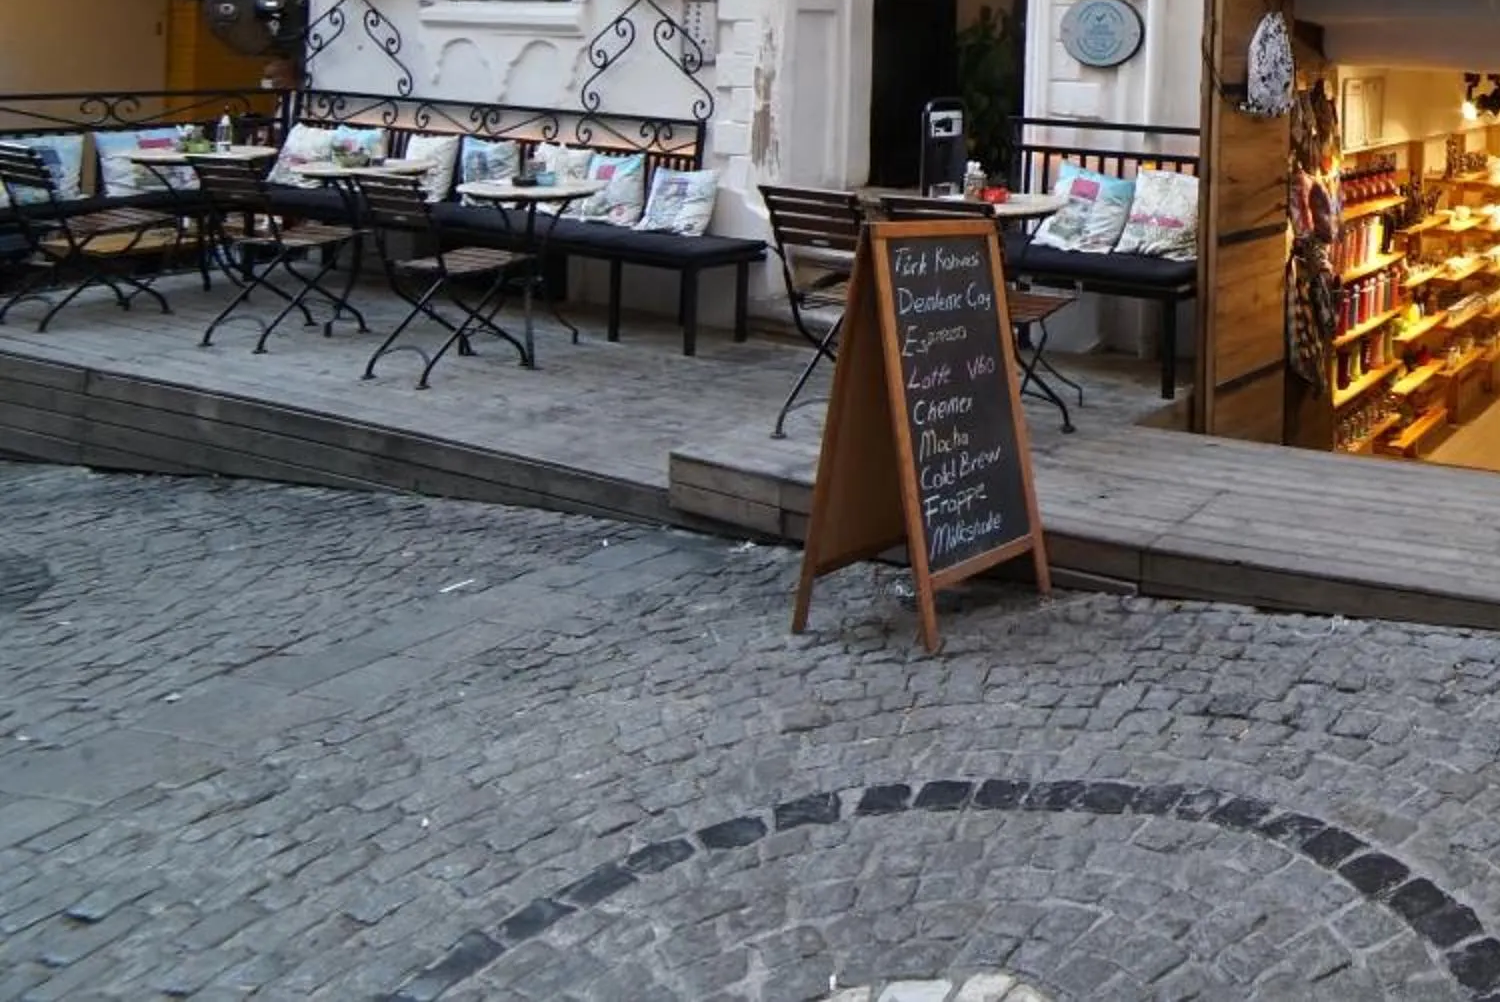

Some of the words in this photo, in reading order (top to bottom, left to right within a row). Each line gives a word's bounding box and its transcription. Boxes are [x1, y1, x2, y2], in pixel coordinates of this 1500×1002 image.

[919, 425, 969, 463] Mocha
[920, 458, 957, 490] Cold
[960, 445, 1001, 478] Brew
[924, 482, 988, 527] Frappe
